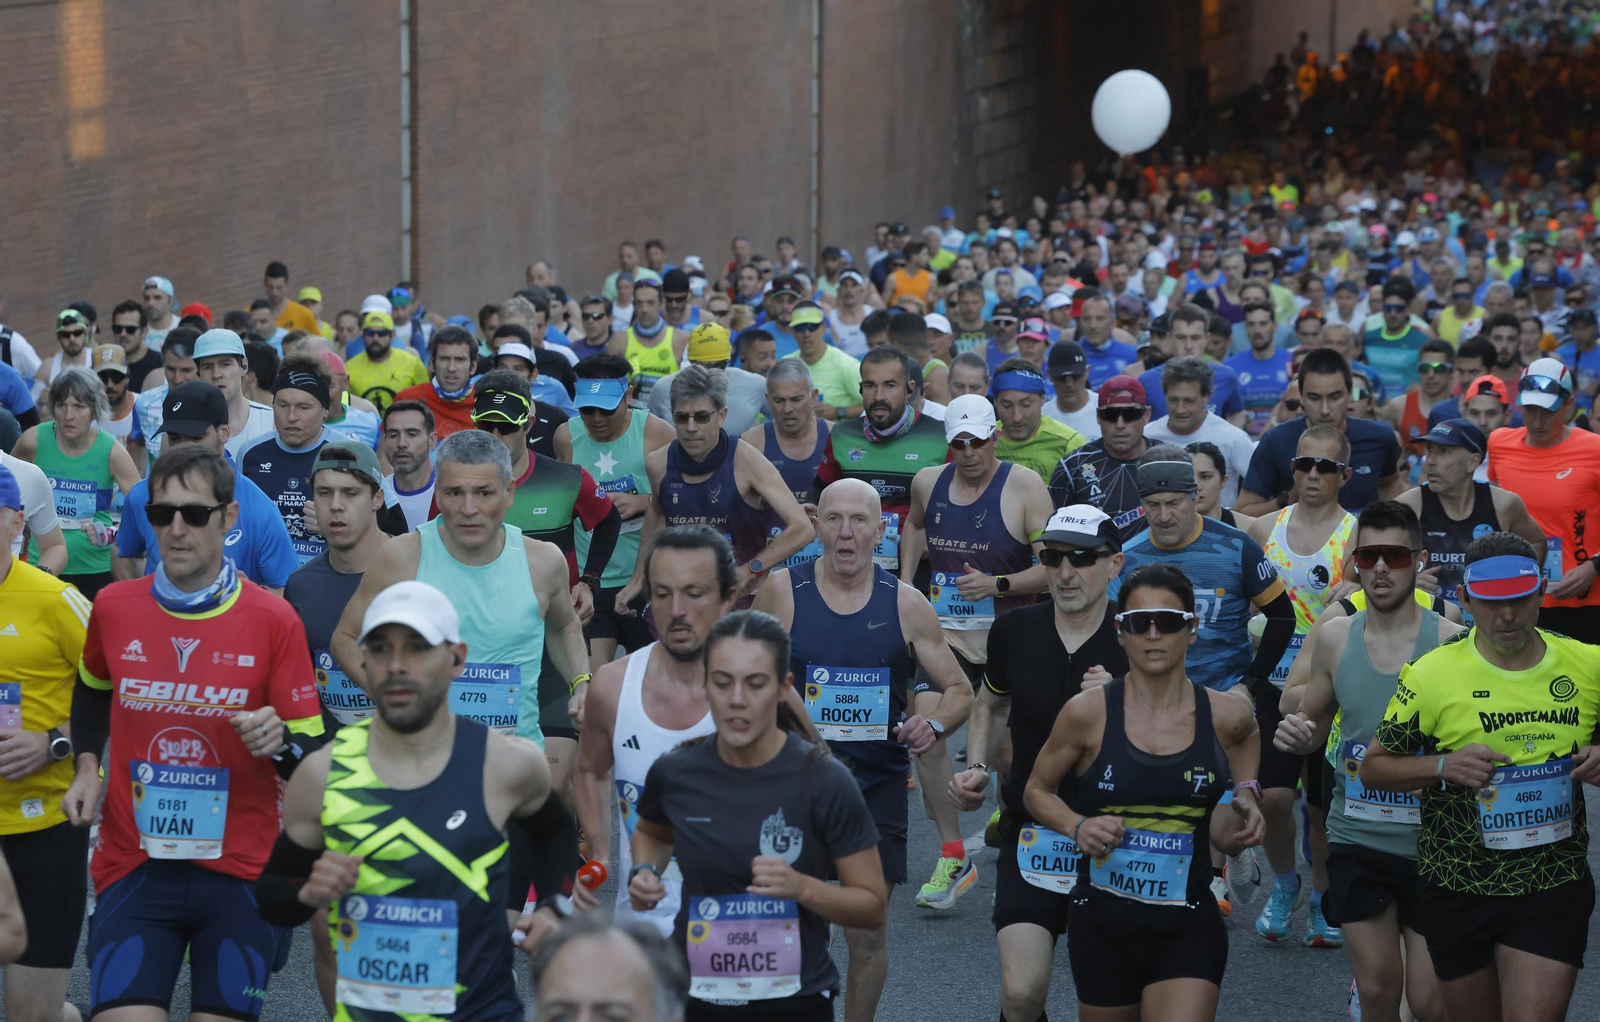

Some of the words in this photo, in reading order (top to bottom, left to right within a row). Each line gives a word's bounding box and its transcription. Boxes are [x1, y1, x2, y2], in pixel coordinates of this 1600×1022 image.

[60, 481, 92, 491] ZURICH
[602, 481, 628, 492] URICH
[59, 496, 77, 504] 7320
[293, 543, 323, 553] URICH
[970, 541, 991, 551] AHÍ
[950, 593, 965, 602] 47
[947, 605, 975, 615] TONI
[460, 668, 510, 679] ZURICH
[834, 672, 880, 682] ZURICH
[119, 677, 249, 705] ISBILYA
[341, 679, 359, 689] 61
[459, 692, 487, 703] 4779
[835, 694, 860, 704] 5884
[120, 697, 225, 717] TRIATHLON
[821, 707, 873, 722] ROCKY
[463, 714, 518, 727] STRAN
[1478, 706, 1580, 734] DEPORTEMANIA
[1504, 733, 1556, 742] CORTEGANA
[158, 771, 217, 786] ZURICH
[1511, 764, 1562, 779] ZURICH
[1098, 781, 1115, 791] BY2
[1360, 788, 1414, 805] JAVIER
[1515, 790, 1543, 803] 4662
[158, 798, 187, 811] 6181
[1482, 802, 1571, 830] CORTEGANA
[150, 813, 194, 836] IVÁN
[1129, 834, 1182, 850] ZURICH
[1126, 859, 1156, 874] 4770
[1109, 871, 1169, 897] MAYTE
[374, 904, 442, 923] ZURICH
[725, 900, 785, 915] ZURICH
[375, 937, 410, 954] 5464
[727, 931, 758, 946] 9584
[710, 951, 778, 973] GRACE
[358, 956, 430, 984] OSCAR
